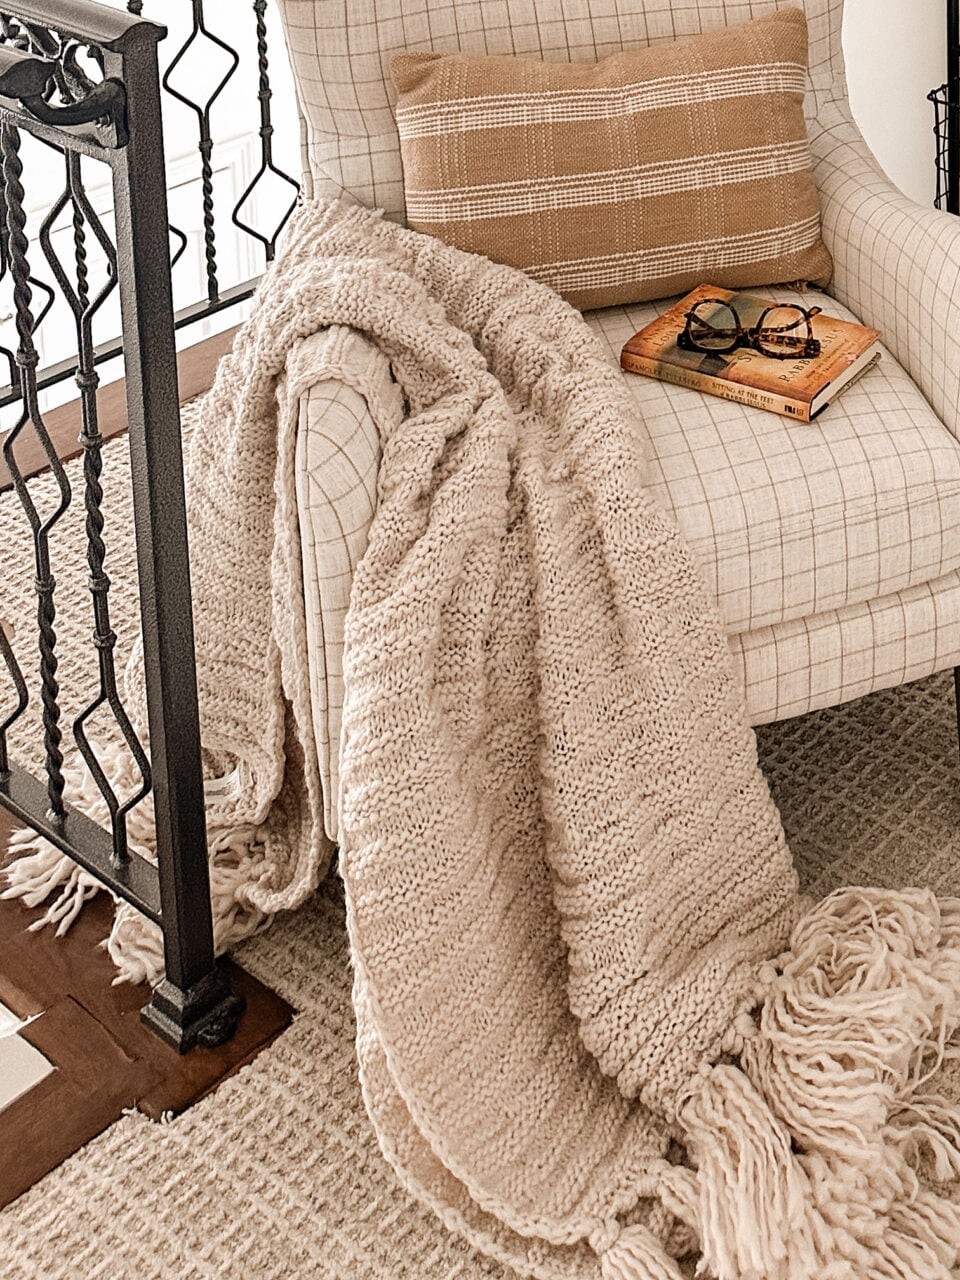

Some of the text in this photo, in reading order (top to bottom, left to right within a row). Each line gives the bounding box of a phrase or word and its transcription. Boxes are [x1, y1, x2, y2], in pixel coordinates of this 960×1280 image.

[778, 357, 811, 383] RABB
[737, 388, 746, 396] AT
[746, 391, 759, 400] THE
[760, 394, 774, 405] FEET
